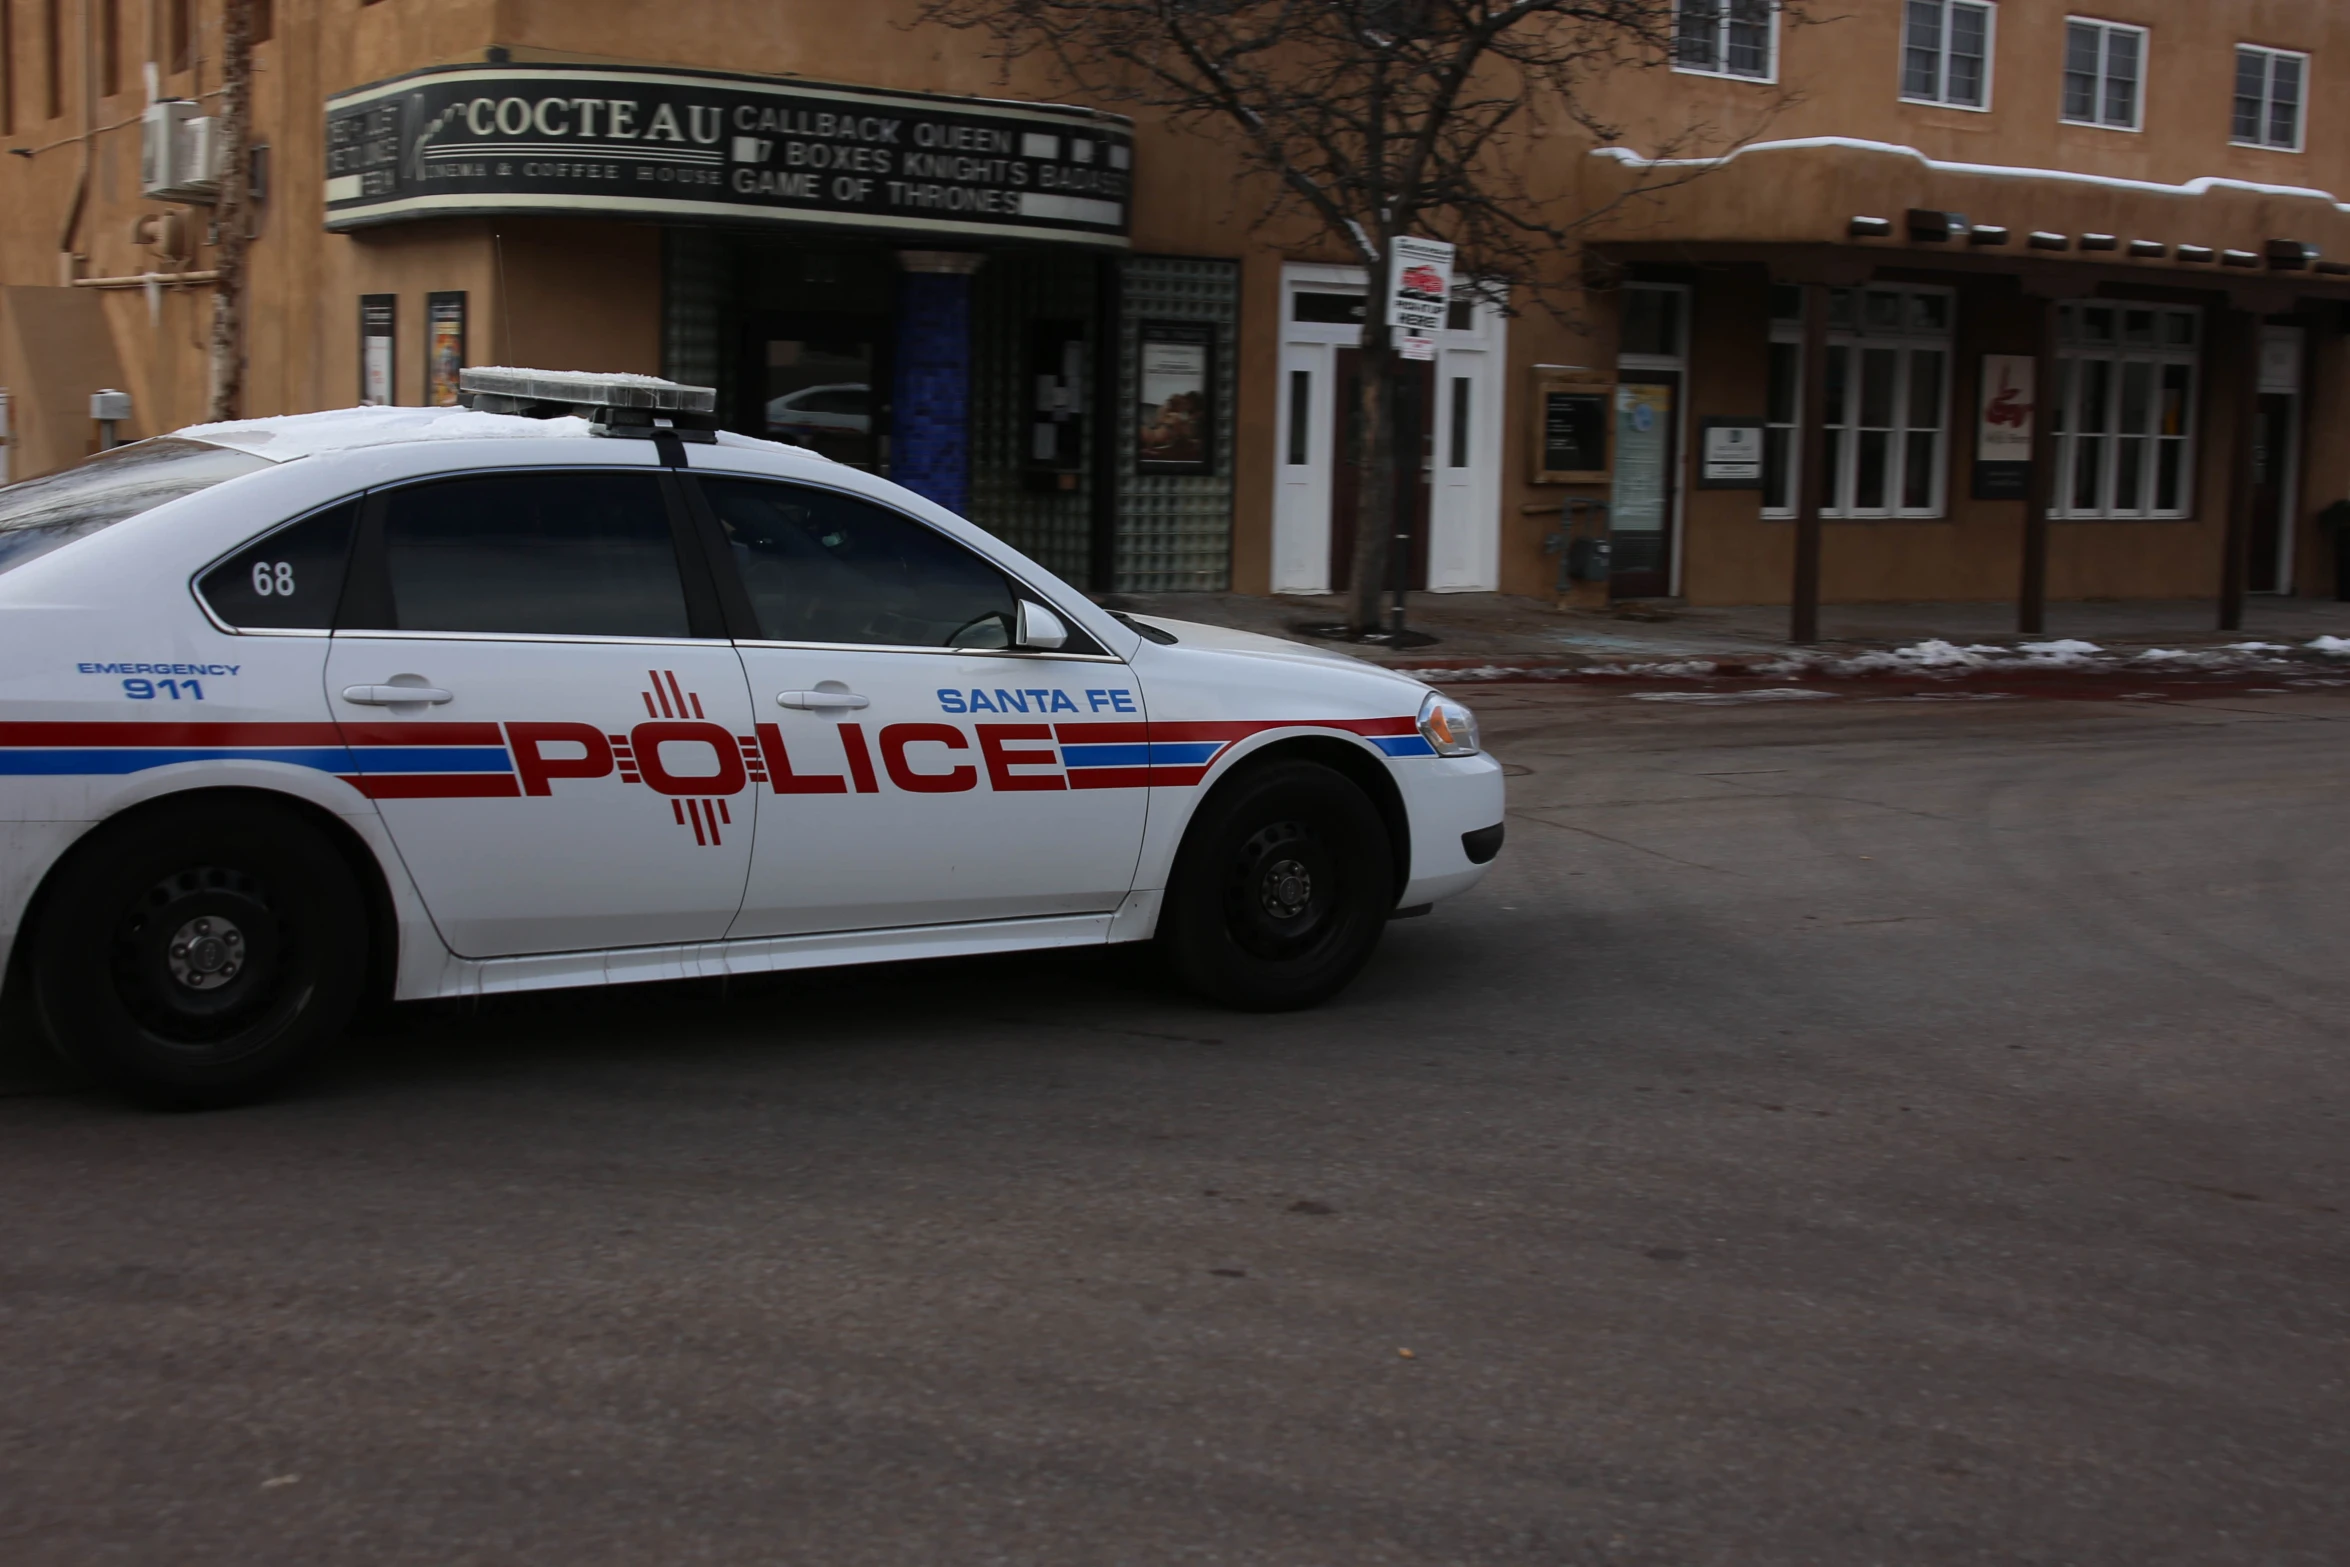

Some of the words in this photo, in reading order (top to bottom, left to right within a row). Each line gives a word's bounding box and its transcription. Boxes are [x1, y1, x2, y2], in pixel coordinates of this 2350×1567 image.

[466, 97, 724, 144] COCTEAU
[733, 105, 902, 143] CALLBACK
[913, 123, 1012, 153] QUEEN
[523, 162, 620, 179] COFFEE
[636, 167, 723, 185] HOUSE
[786, 141, 892, 173] BOXES
[903, 151, 1028, 185] KNIGHTS
[732, 168, 821, 198] GAME
[832, 176, 873, 201] OF
[886, 181, 1020, 215] THRONES
[252, 561, 295, 597] 68
[77, 662, 241, 676] EMERGENCY
[123, 679, 204, 700] 911
[937, 689, 1079, 713] SANTA
[1086, 689, 1137, 713] FE
[505, 721, 1068, 797] POLICE
